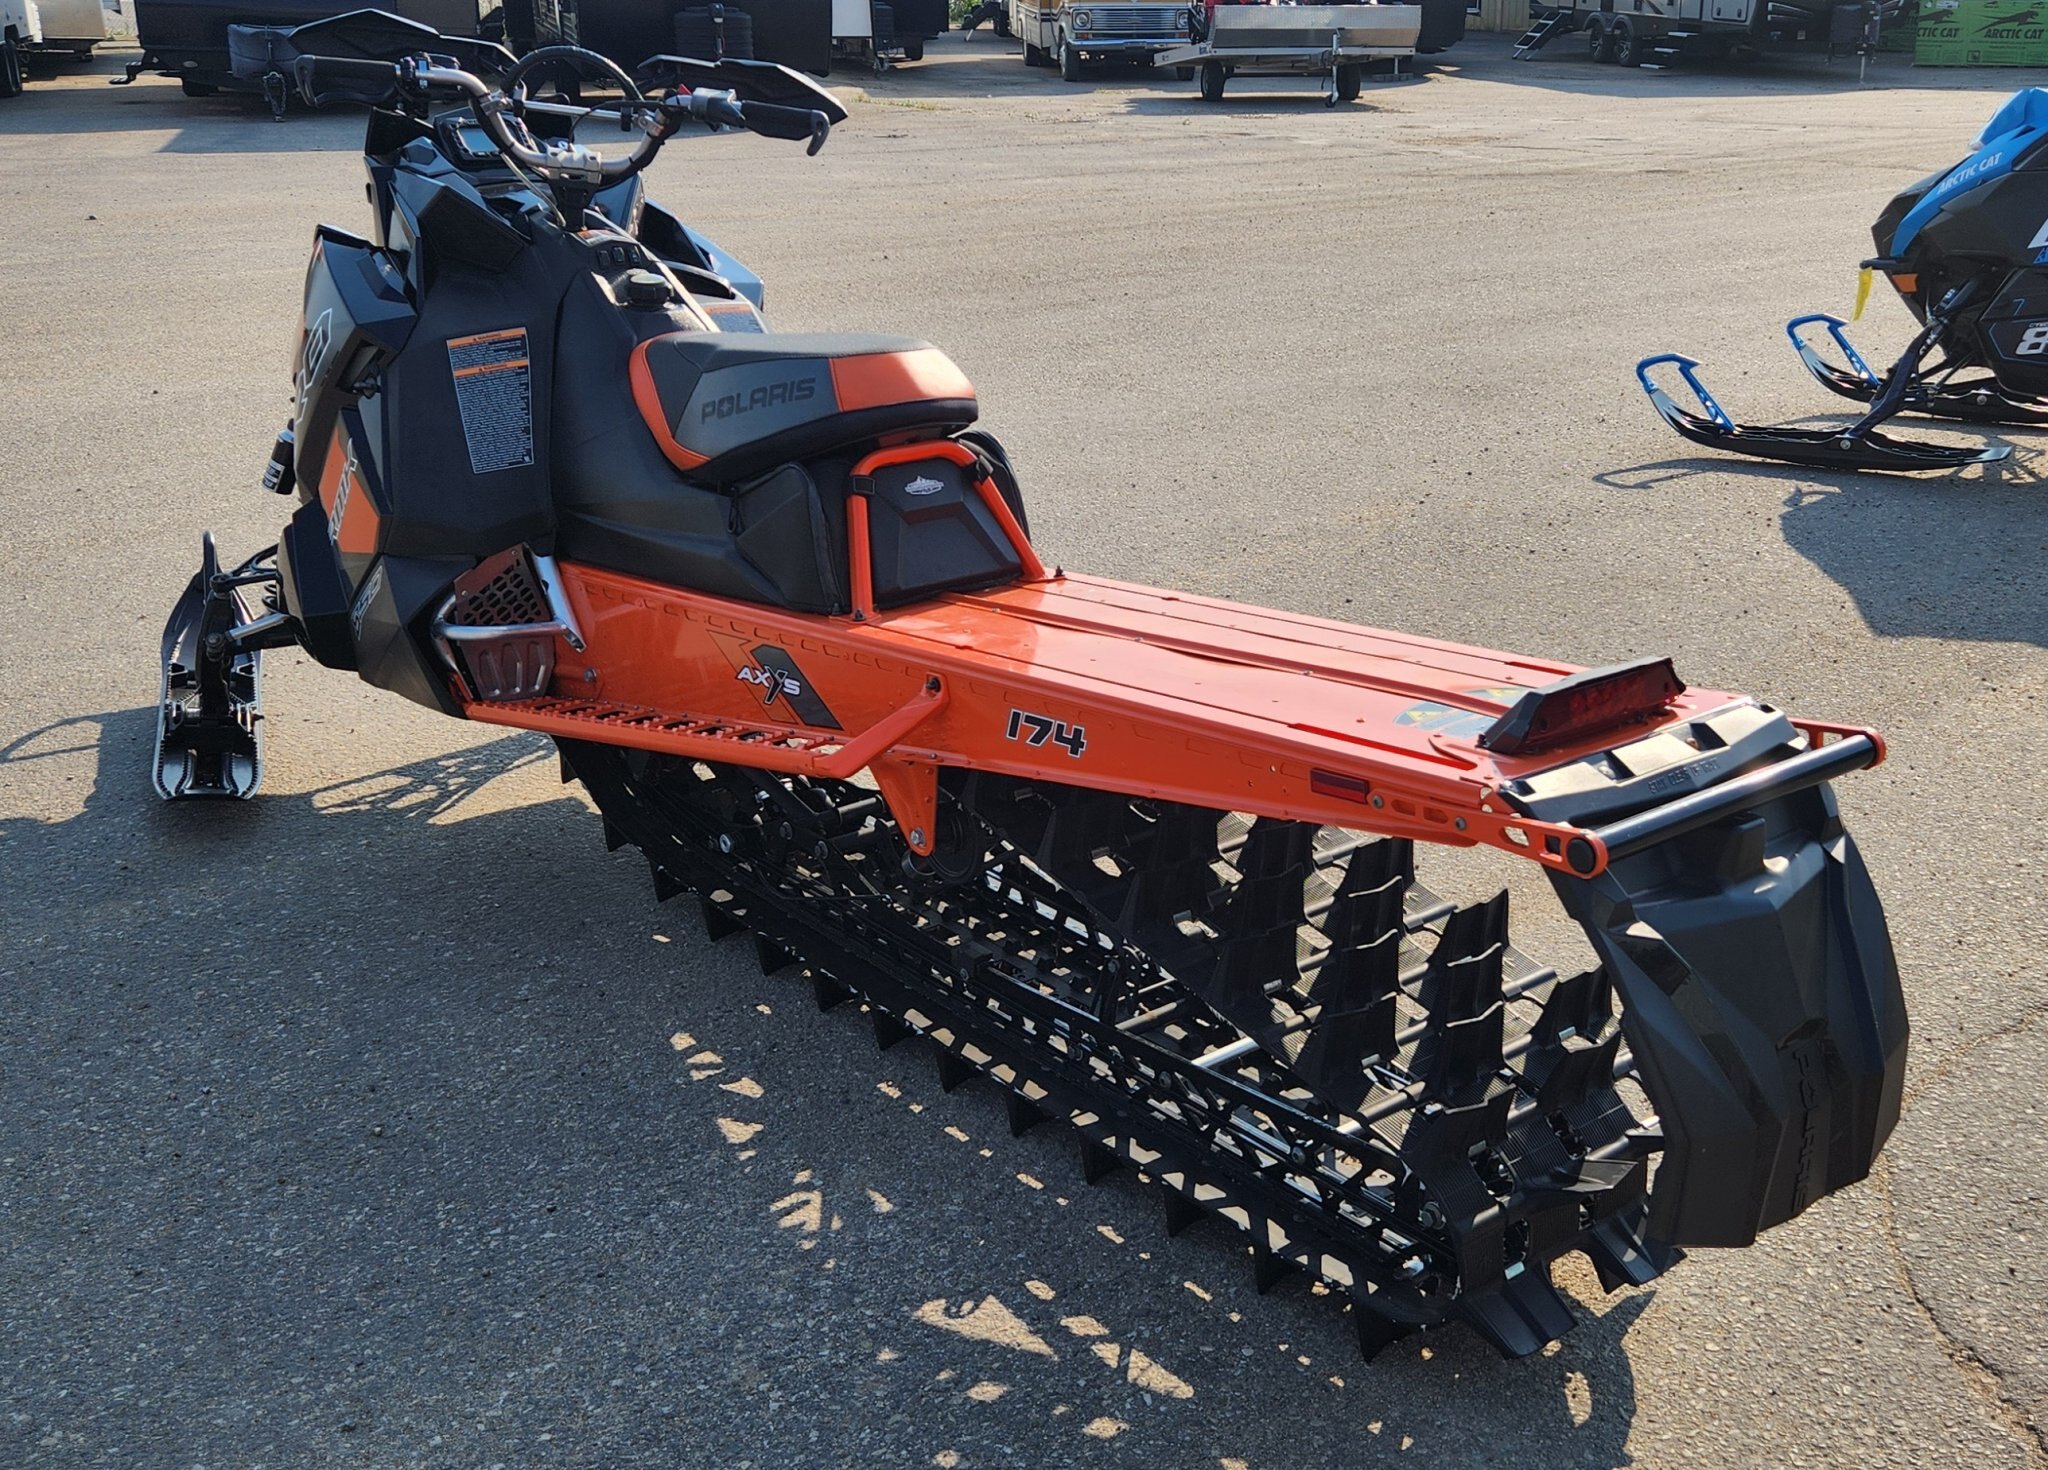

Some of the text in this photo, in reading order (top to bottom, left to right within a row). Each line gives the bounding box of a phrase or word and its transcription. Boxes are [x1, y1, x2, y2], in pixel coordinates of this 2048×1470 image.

[1940, 28, 1960, 38] CAT
[1983, 28, 2045, 39] ARCTIC CAT
[1937, 152, 2003, 194] ARCTIC CAT
[701, 378, 816, 424] POLARIS
[737, 665, 800, 705] AXYS
[1006, 708, 1087, 759] 174
